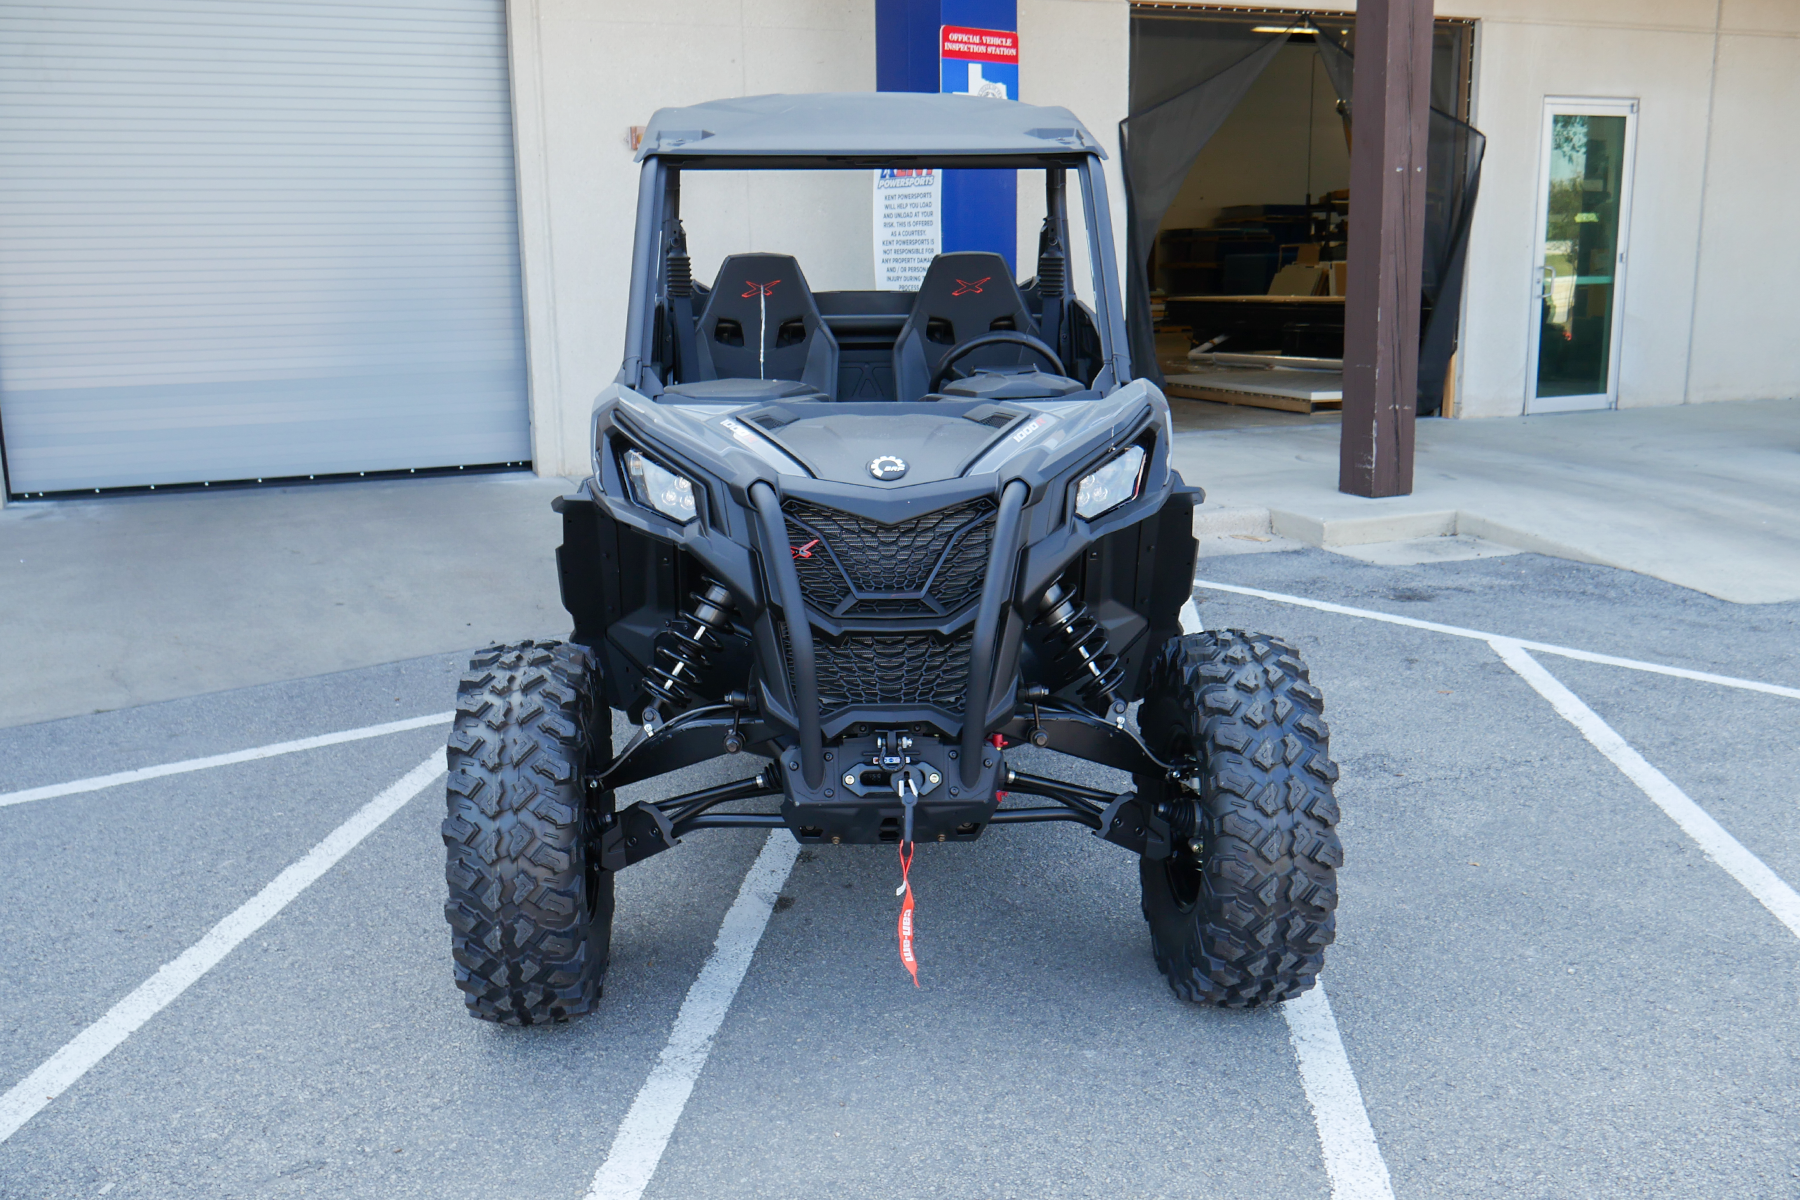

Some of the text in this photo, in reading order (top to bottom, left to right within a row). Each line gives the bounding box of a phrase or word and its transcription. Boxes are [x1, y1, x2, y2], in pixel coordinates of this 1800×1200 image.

[949, 33, 1012, 46] OFFICIAL VEHICLE
[944, 42, 1017, 56] INSPECTION STATION
[878, 175, 934, 189] POWERSPORTS
[898, 192, 932, 200] POWERSPORTS
[720, 419, 758, 443] 1000R
[1013, 418, 1047, 443] 1000R
[902, 909, 914, 961] can-am
